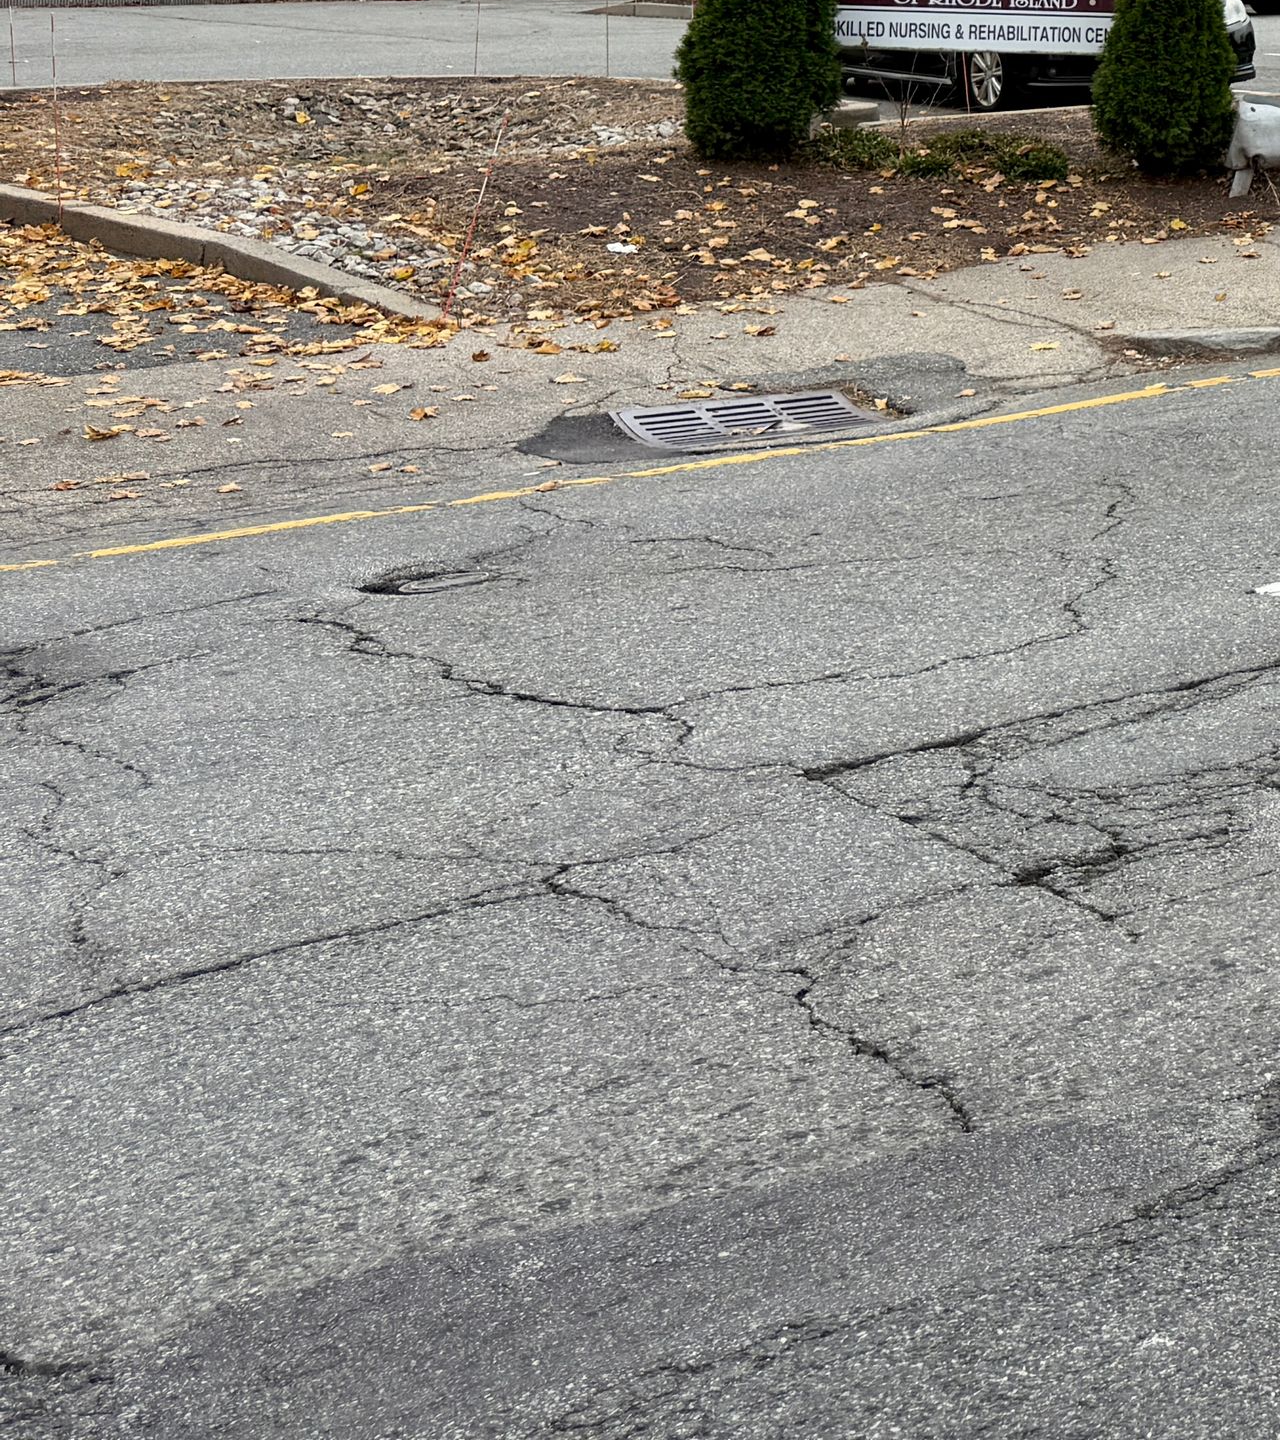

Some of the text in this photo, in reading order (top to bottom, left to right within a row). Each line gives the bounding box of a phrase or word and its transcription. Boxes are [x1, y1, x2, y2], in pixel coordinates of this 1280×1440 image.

[889, 21, 951, 40] NURSING
[955, 24, 965, 40] &
[969, 24, 1082, 44] REHABILITATION
